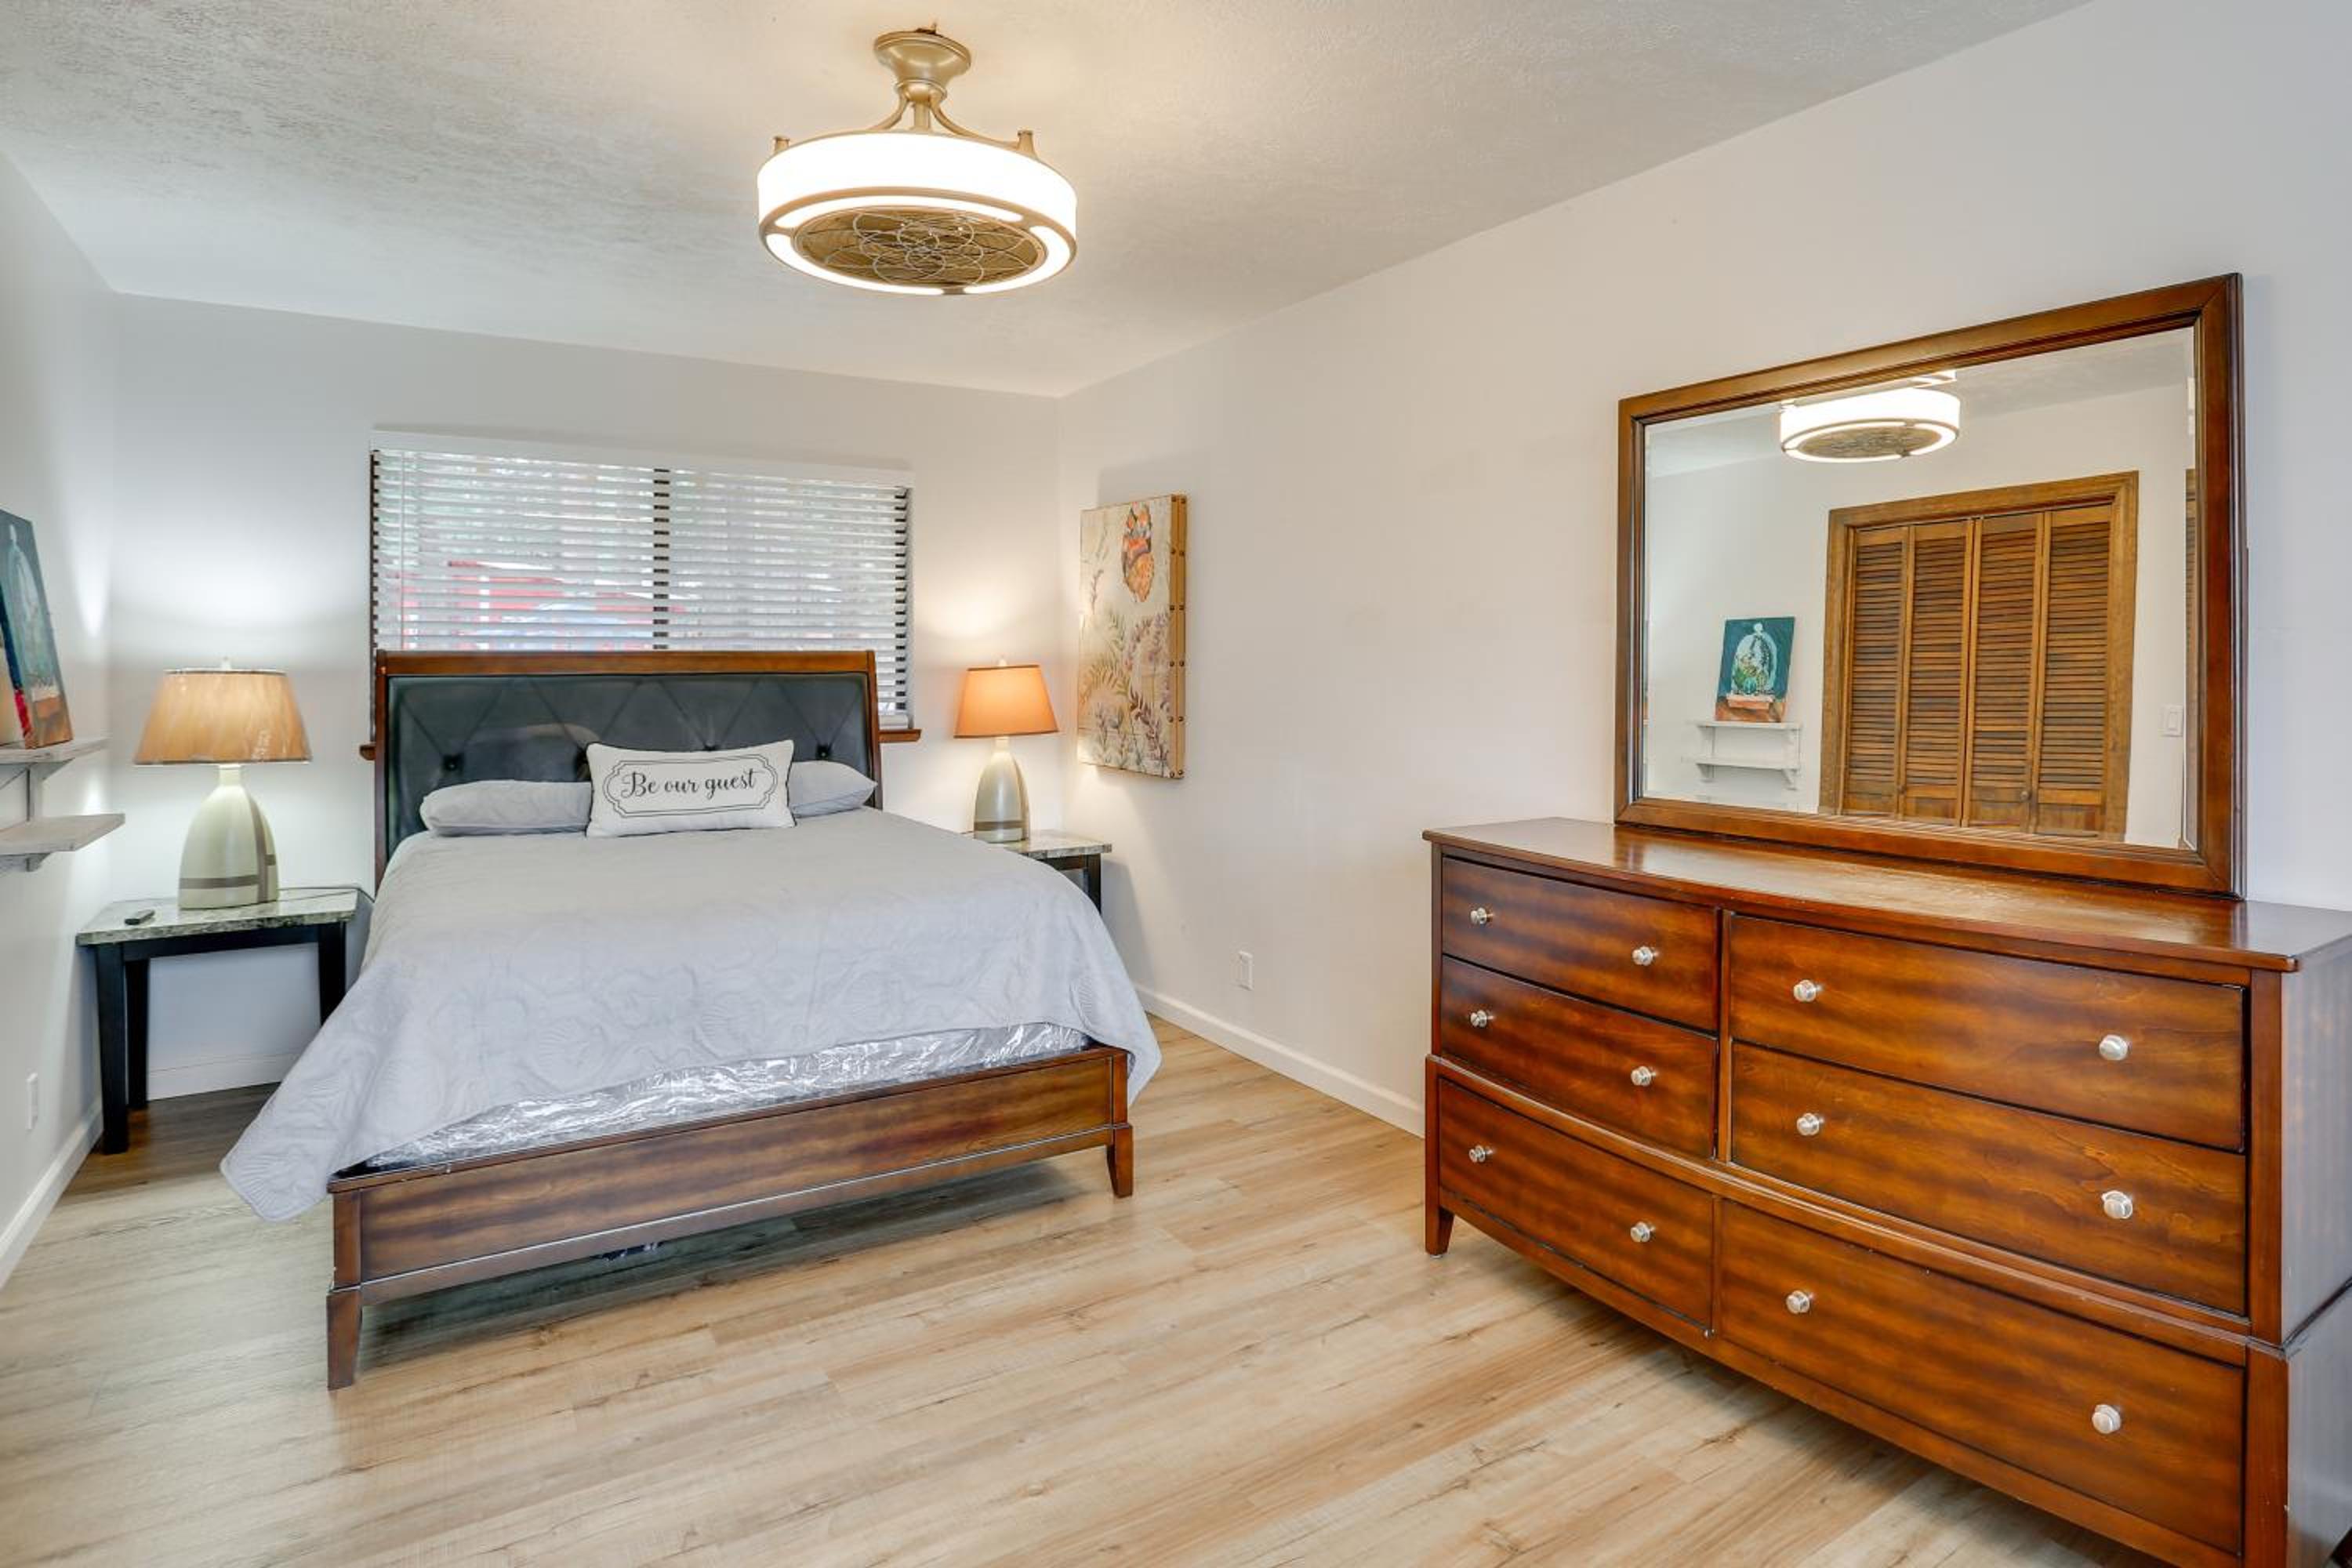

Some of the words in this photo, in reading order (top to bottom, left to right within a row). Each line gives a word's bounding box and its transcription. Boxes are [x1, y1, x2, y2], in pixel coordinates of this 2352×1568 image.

[620, 771, 658, 798] Be
[664, 780, 700, 793] our
[705, 768, 763, 800] guest
